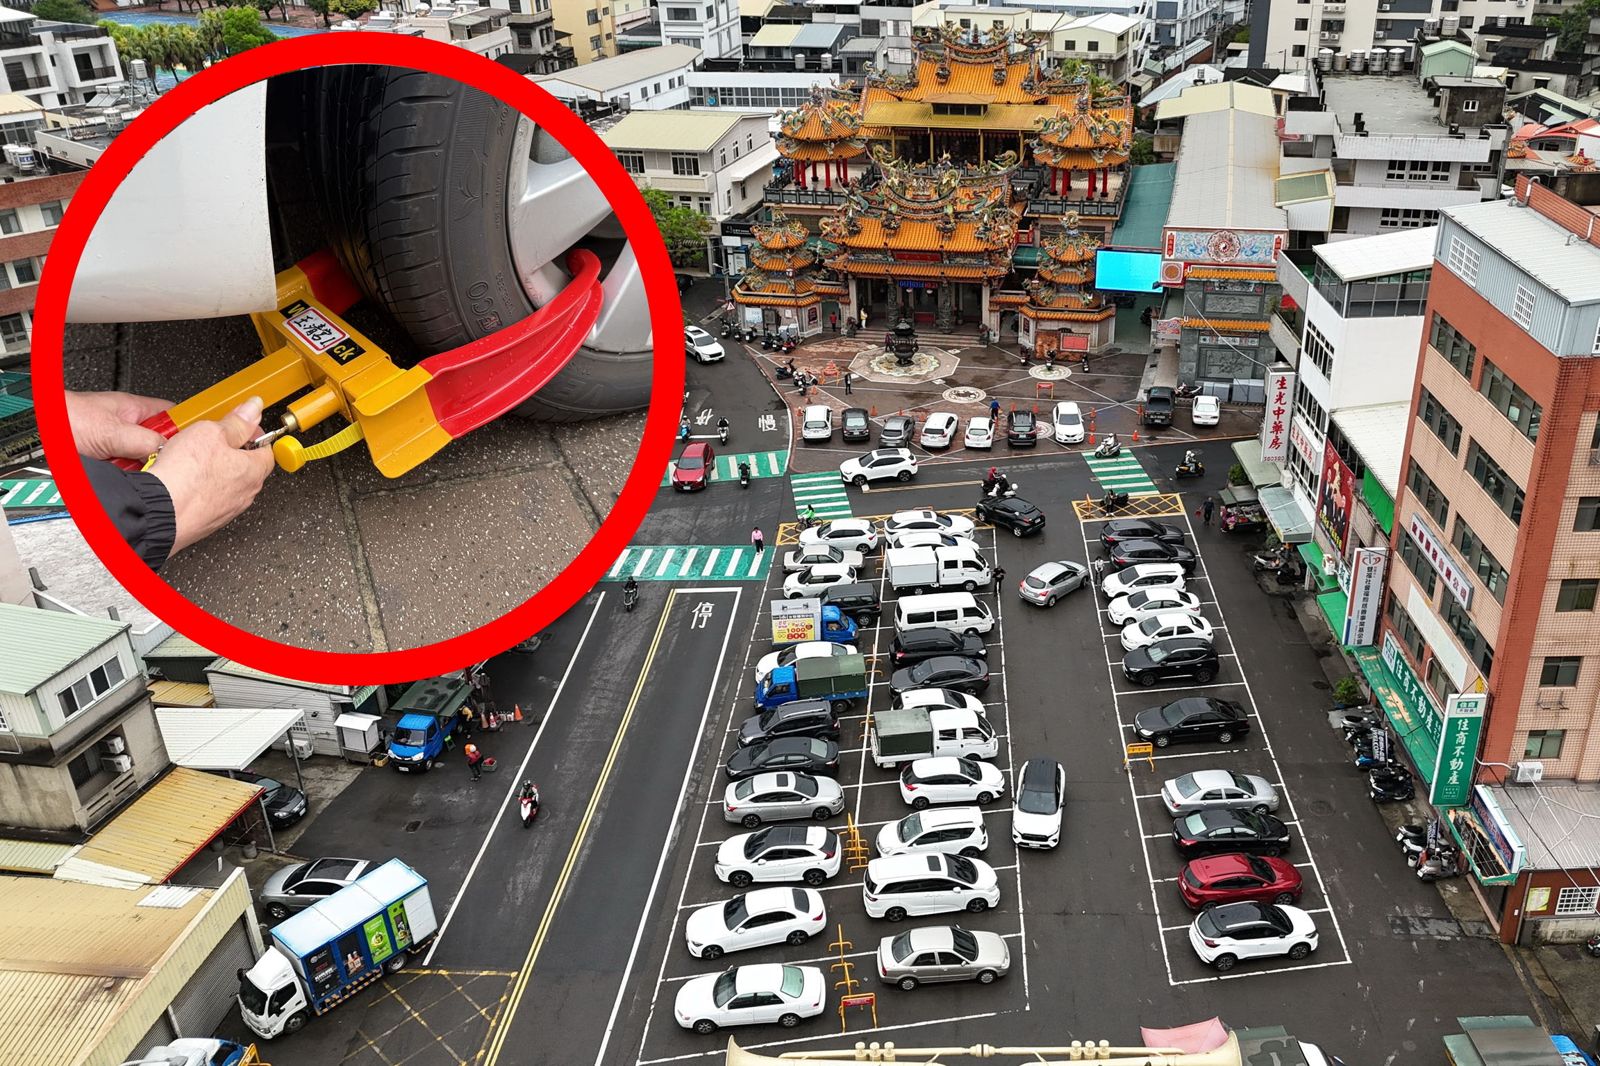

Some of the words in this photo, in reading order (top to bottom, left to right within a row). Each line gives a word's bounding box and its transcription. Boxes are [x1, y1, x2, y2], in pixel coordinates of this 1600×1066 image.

[1268, 375, 1288, 450] 生光中藥房
[690, 601, 715, 630] 停
[786, 632, 806, 640] 800
[1395, 658, 1434, 734] 住商不動產
[1447, 718, 1470, 785] 住商不動產
